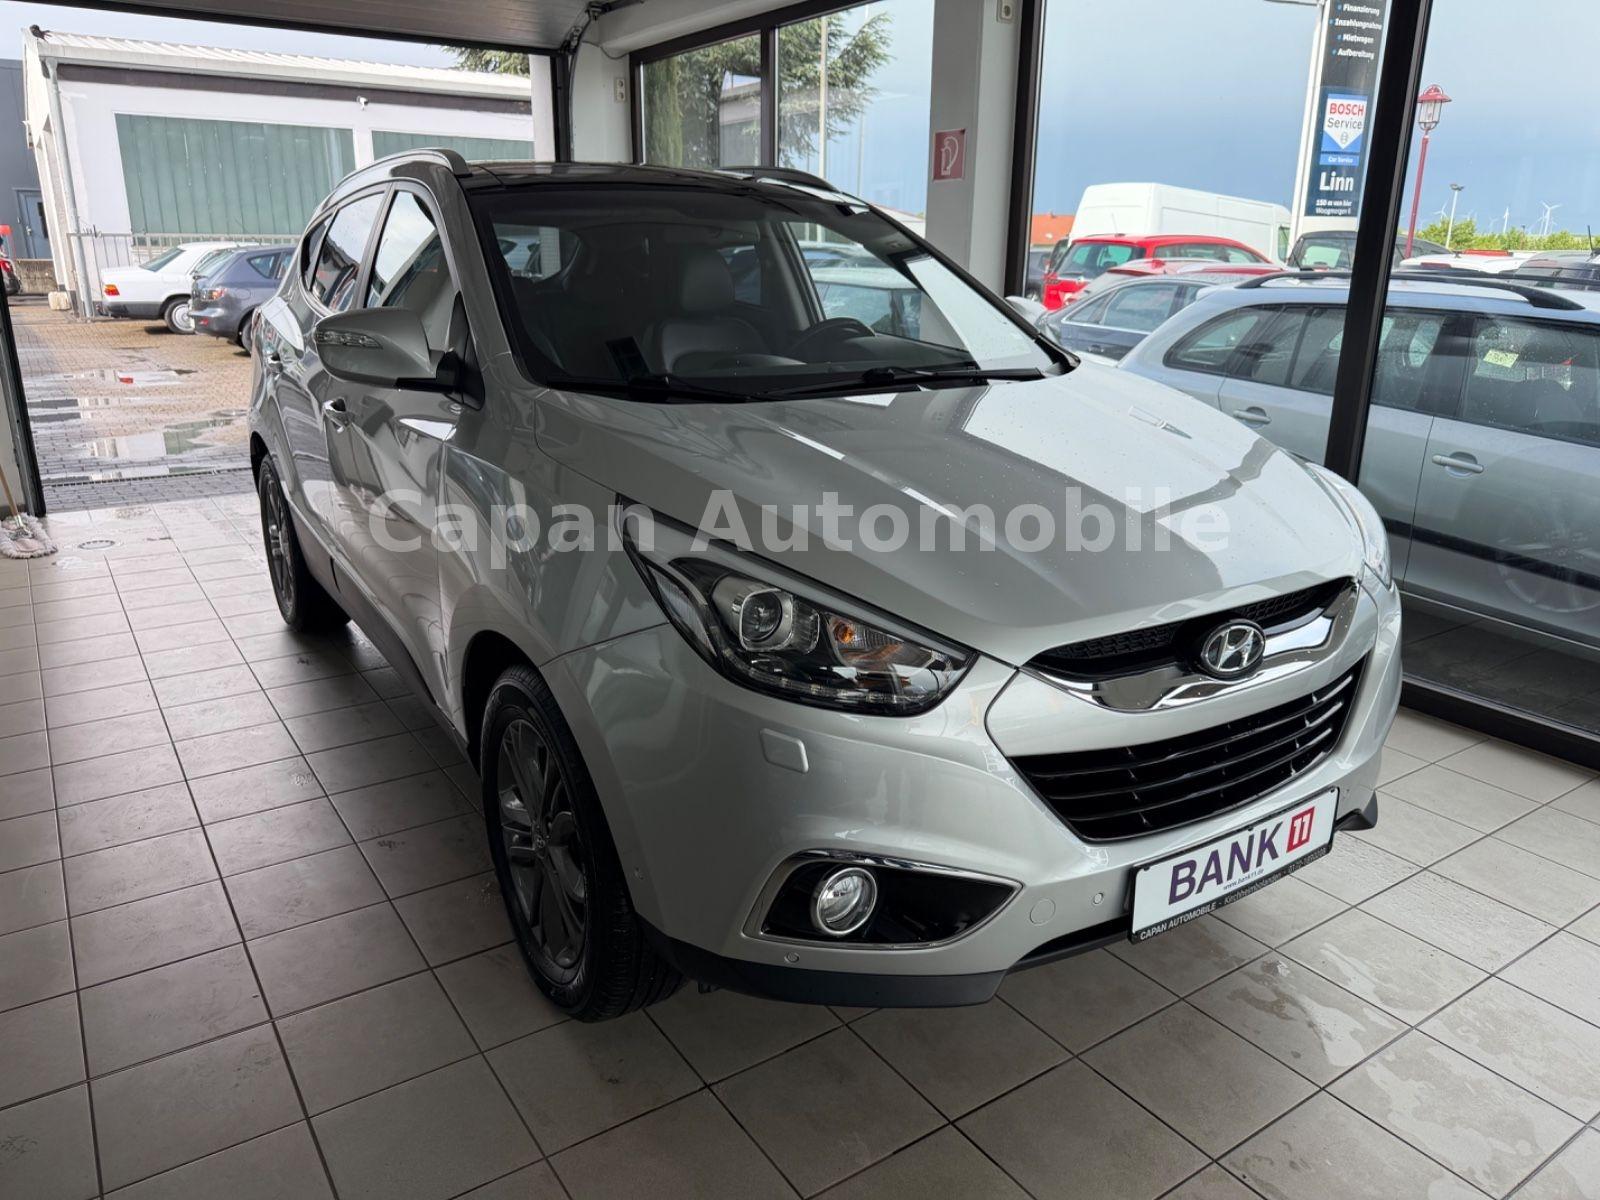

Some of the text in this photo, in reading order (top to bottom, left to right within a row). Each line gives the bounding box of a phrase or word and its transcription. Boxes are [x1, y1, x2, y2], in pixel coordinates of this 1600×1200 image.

[1329, 103, 1365, 116] BOSCH
[1327, 117, 1363, 130] Service
[1320, 171, 1354, 192] Linn
[1168, 821, 1284, 905] BANK
[1140, 921, 1167, 941] CAPAN
[1168, 901, 1217, 929] AUTOMOBILE
